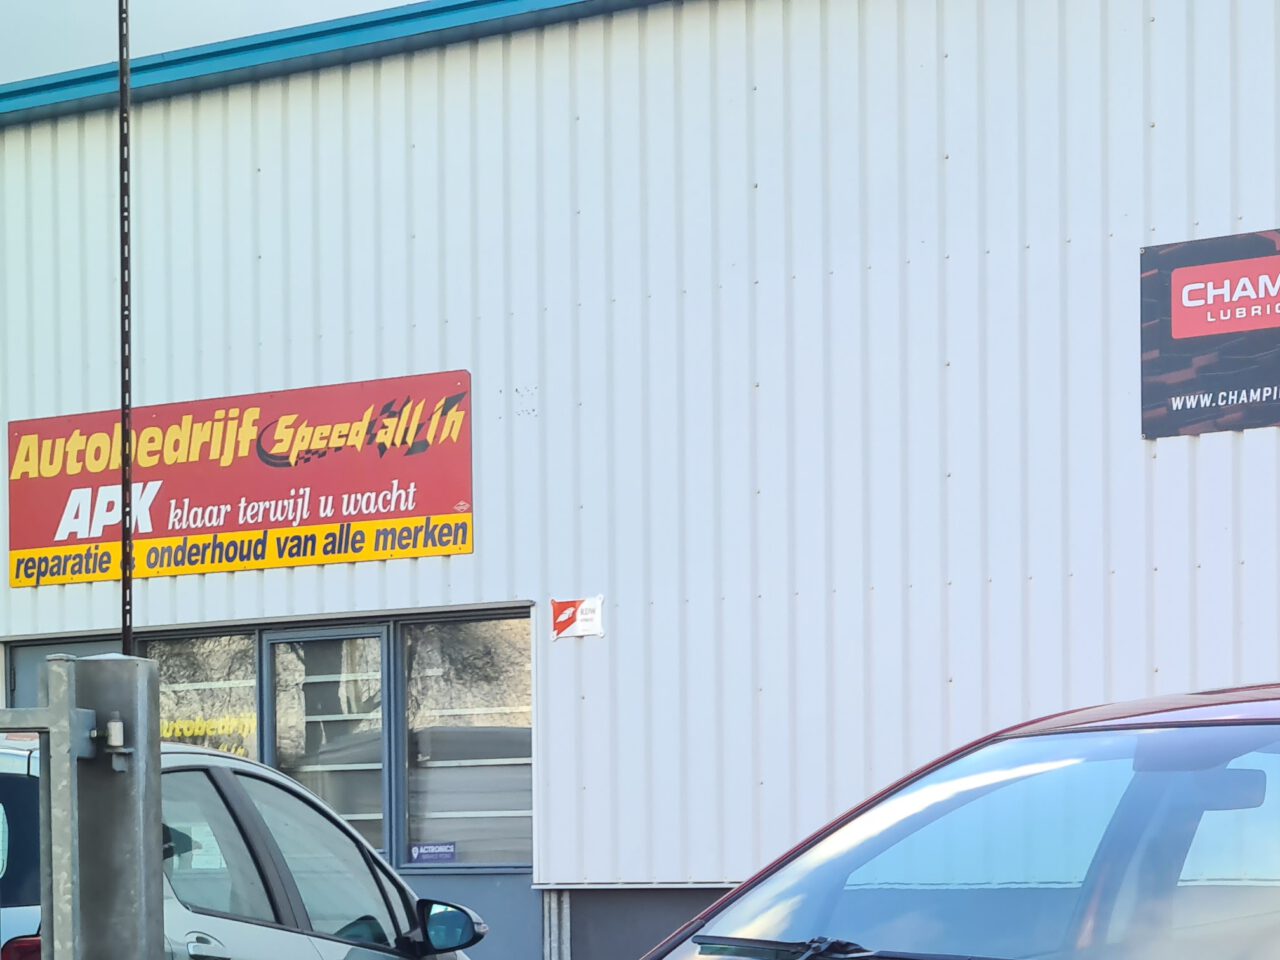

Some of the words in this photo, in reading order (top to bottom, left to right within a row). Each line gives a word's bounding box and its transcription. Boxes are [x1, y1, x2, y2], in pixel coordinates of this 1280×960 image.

[10, 407, 261, 480] Autobedrijf
[269, 404, 374, 467] Speed
[54, 480, 163, 542] APK
[168, 498, 231, 530] klaar
[238, 487, 311, 527] terwijl
[318, 495, 335, 517] u
[341, 479, 417, 517] wacht
[15, 545, 112, 586] reparatie
[146, 528, 268, 570] onderhoud
[276, 533, 316, 560] van
[323, 523, 365, 556] alle
[374, 517, 468, 552] merken
